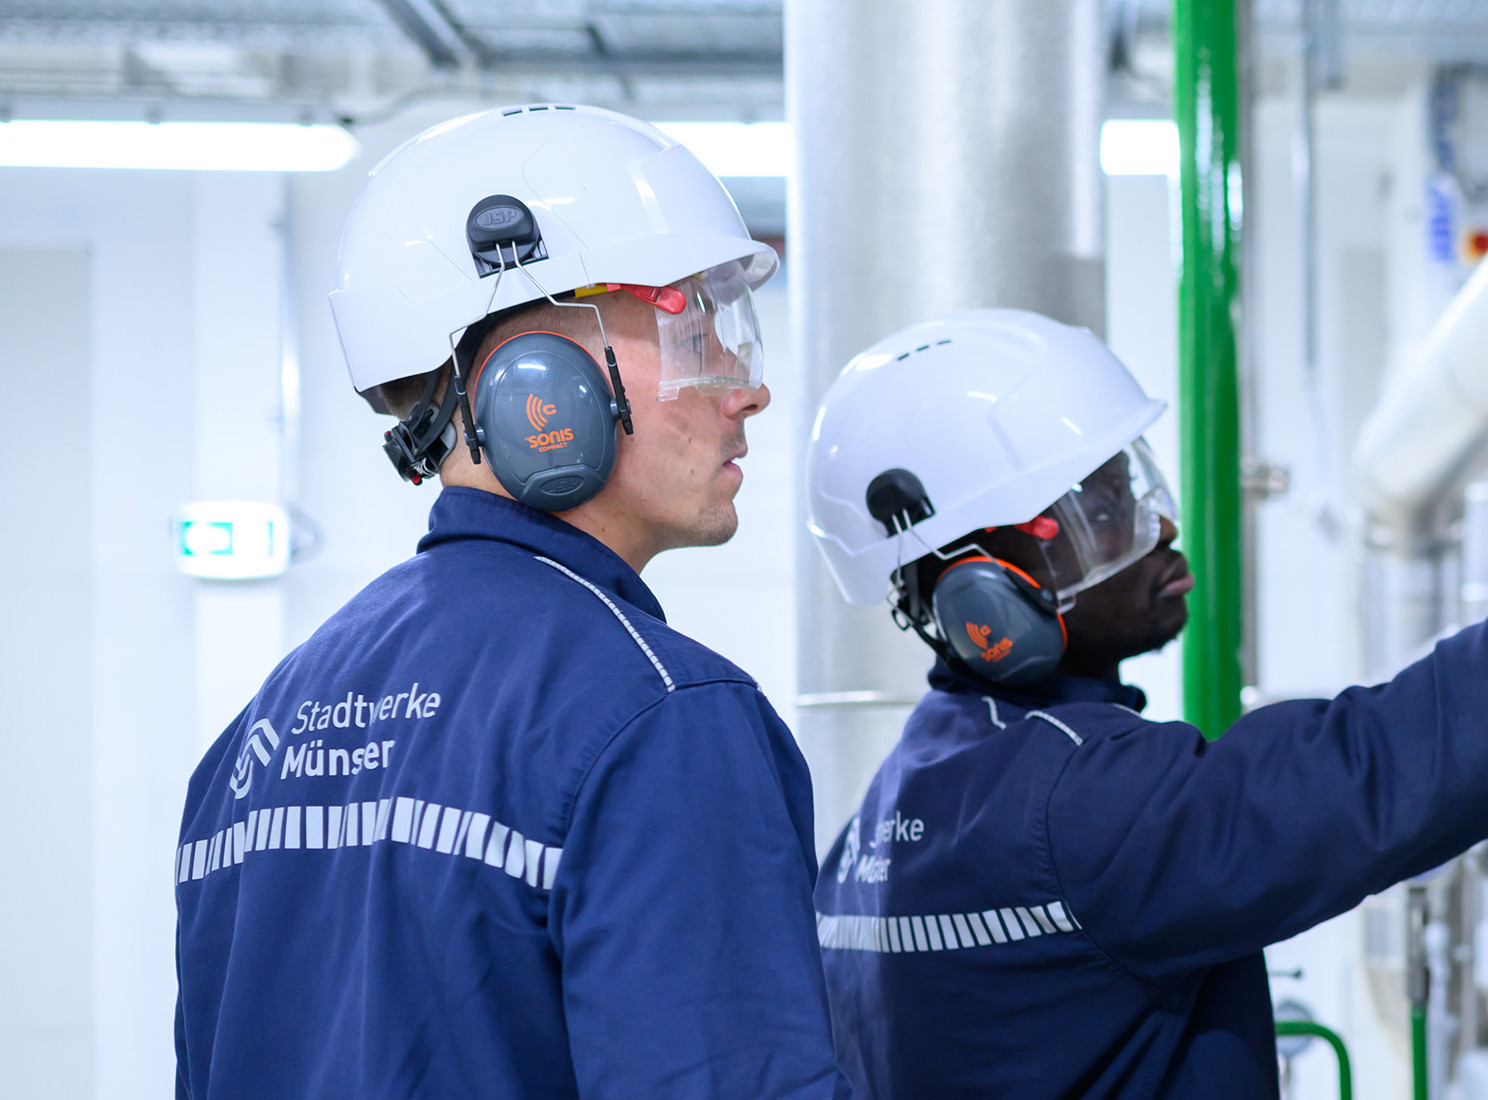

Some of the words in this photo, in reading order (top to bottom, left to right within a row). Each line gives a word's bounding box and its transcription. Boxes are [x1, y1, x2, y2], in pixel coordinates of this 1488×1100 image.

[482, 210, 518, 227] JSP
[526, 428, 574, 449] SONIS
[280, 739, 396, 780] Münser
